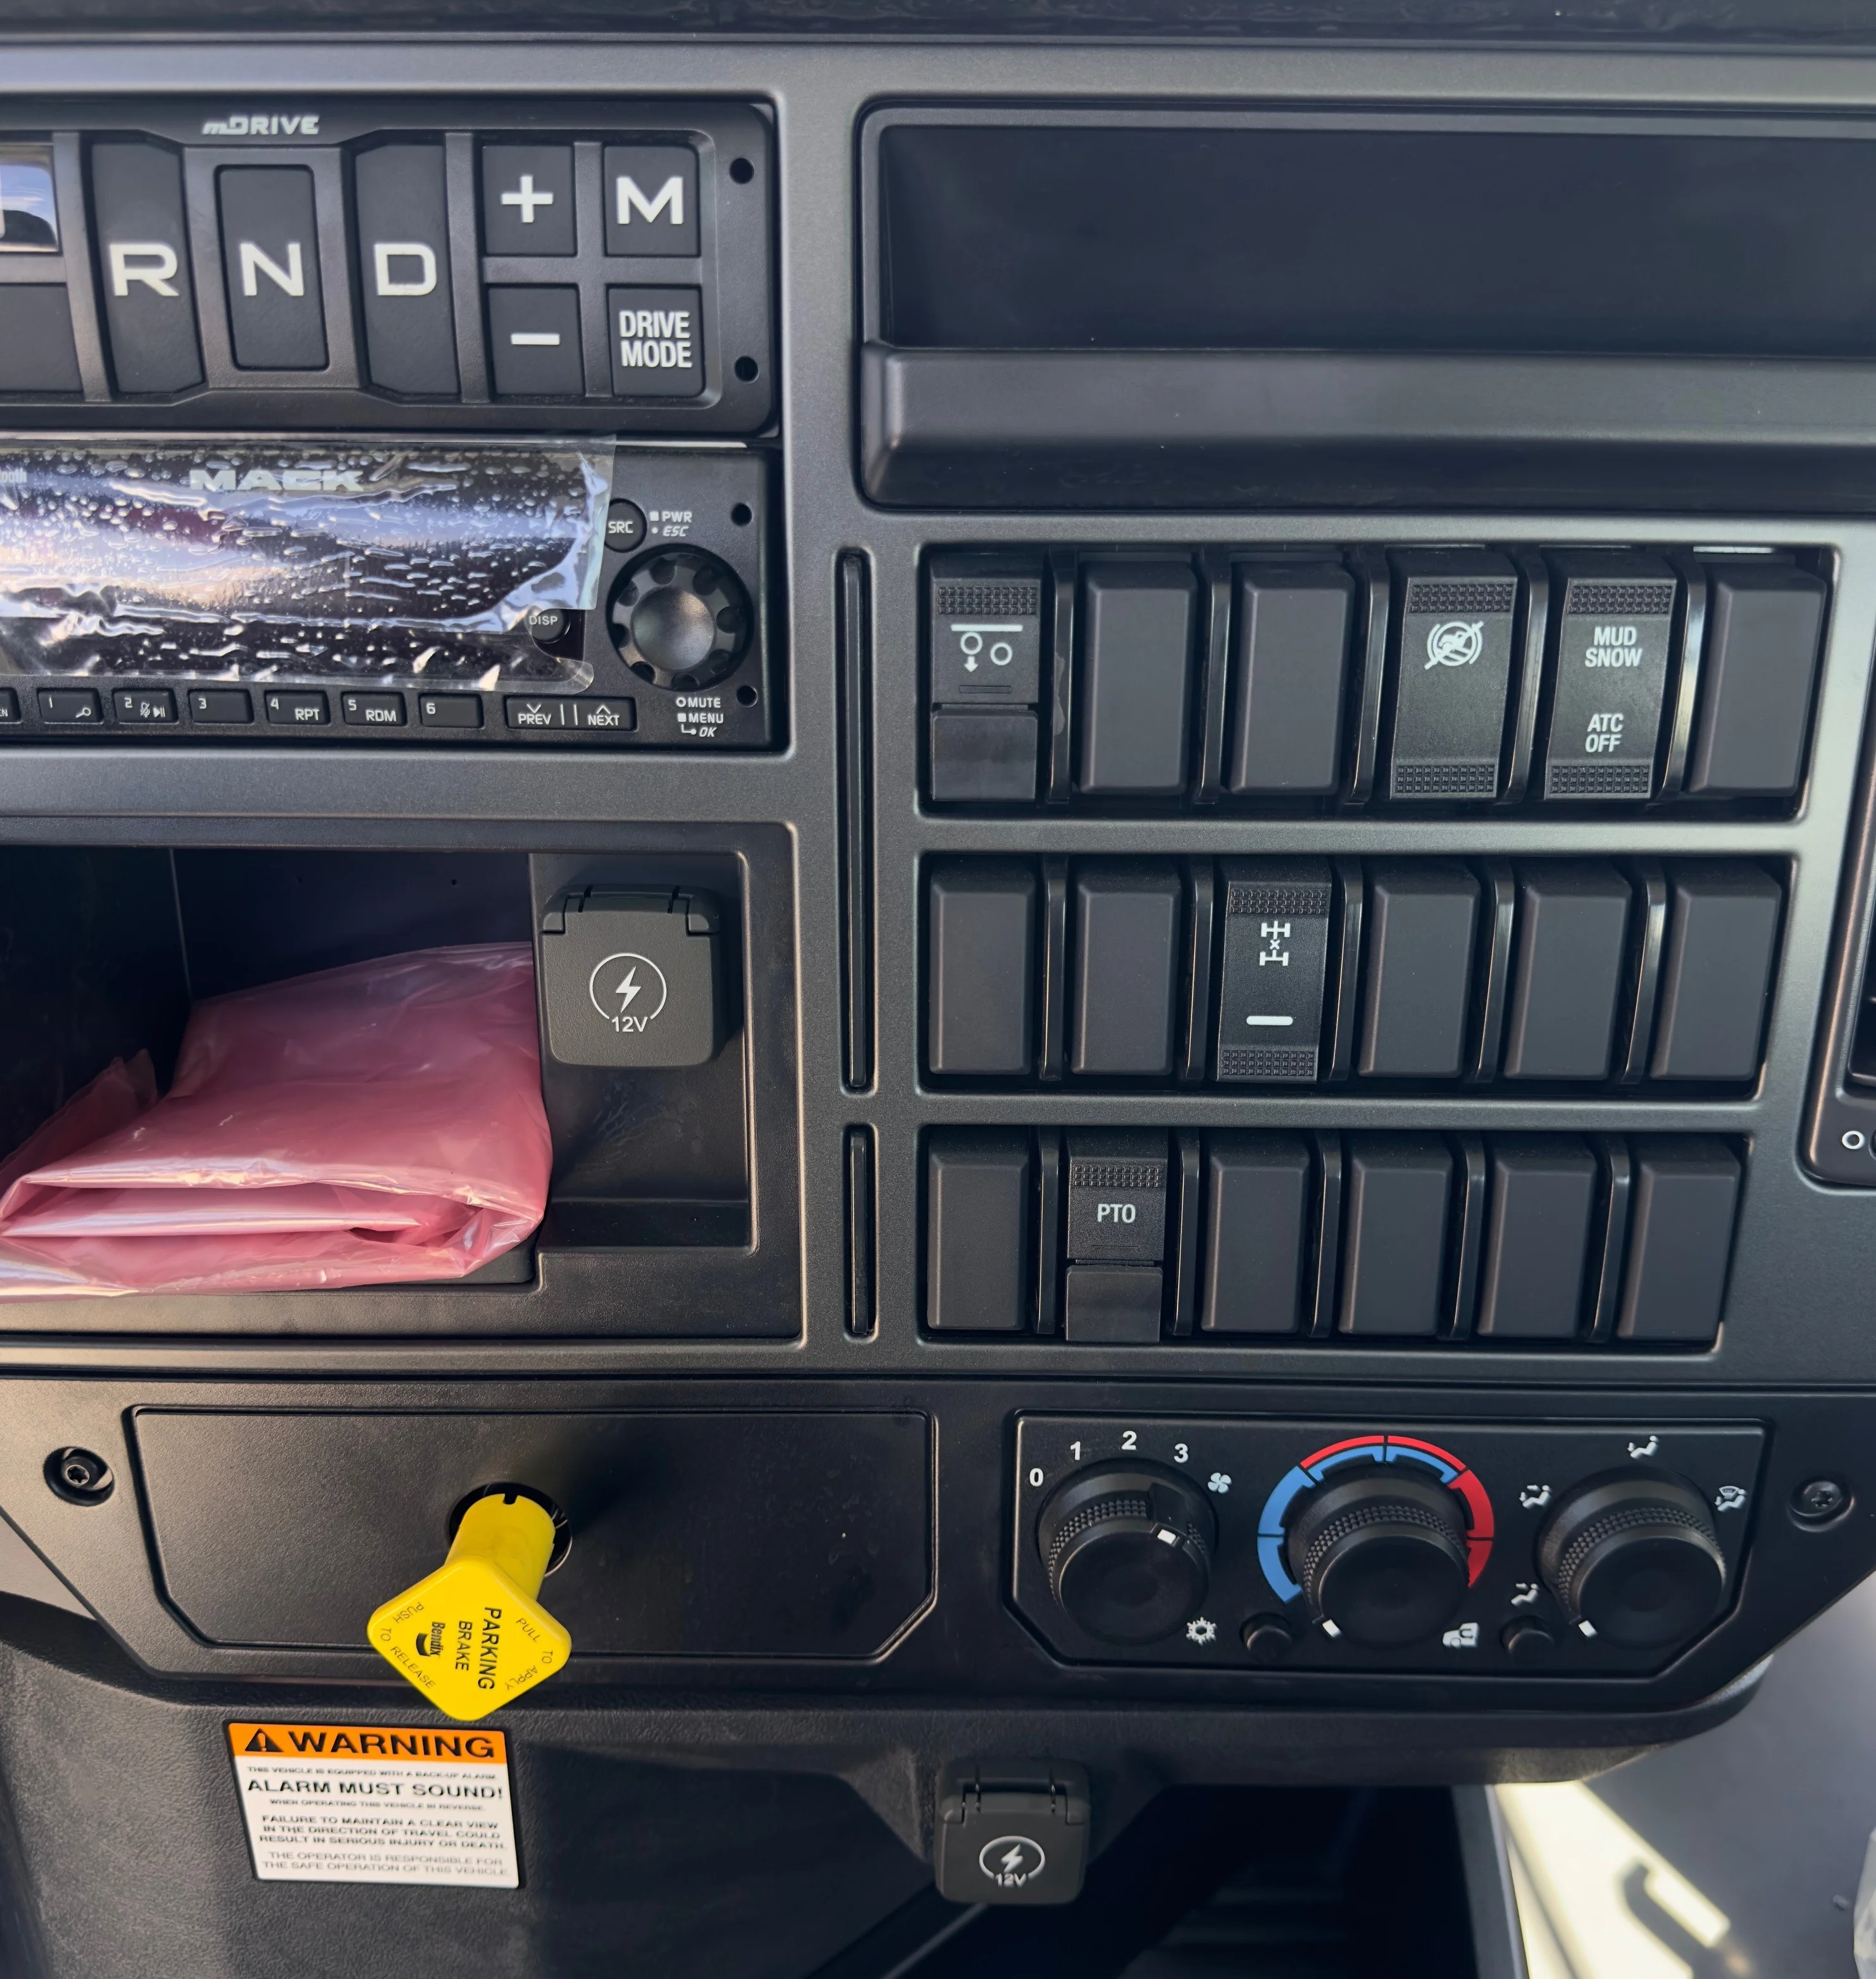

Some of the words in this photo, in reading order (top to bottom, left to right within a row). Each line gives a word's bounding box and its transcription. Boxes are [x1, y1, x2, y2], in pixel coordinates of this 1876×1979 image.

[616, 176, 683, 225] M
[109, 243, 179, 296] R
[240, 243, 304, 296] N
[374, 243, 438, 296] D
[619, 310, 690, 339] DRIVE
[621, 340, 693, 368] MODE
[190, 469, 363, 491] MACK
[661, 511, 692, 523] PWR
[608, 521, 633, 534] SRC
[662, 525, 690, 537] ESC
[529, 615, 558, 626] DISP
[1593, 626, 1638, 647] MUD
[1584, 647, 1643, 668] SNOW
[124, 697, 133, 709] 2
[199, 697, 207, 709] 3
[270, 698, 280, 710] 4
[348, 699, 357, 711] 5
[426, 702, 436, 715] 6
[688, 697, 721, 708] MUTE
[295, 709, 320, 721] RPT
[366, 709, 397, 722] RDM
[518, 713, 552, 725] PREV
[587, 714, 620, 727] NEXT
[688, 713, 724, 724] MENU
[1586, 713, 1624, 733] ATC
[699, 727, 717, 737] OK
[1585, 734, 1622, 753] OFF
[612, 1016, 648, 1032] 12V
[1096, 1204, 1136, 1223] PTO
[1122, 1430, 1137, 1451] 2
[1070, 1441, 1081, 1460] 1
[1174, 1443, 1189, 1463] 3
[1029, 1468, 1043, 1487] 0
[392, 1602, 425, 1623] PUSH
[380, 1627, 392, 1642] TO
[430, 1621, 445, 1656] Bendix
[516, 1618, 540, 1643] PULL
[455, 1620, 473, 1671] BRAKE
[478, 1606, 502, 1690] PARKING
[542, 1650, 553, 1664] TO
[390, 1645, 437, 1689] RELEASE
[504, 1665, 538, 1690] APPLY
[289, 1731, 495, 1758] WARNING
[248, 1779, 331, 1794] ALARM
[339, 1782, 404, 1795] MUST
[413, 1783, 503, 1799] SOUND!
[301, 1799, 357, 1807] OPERATING
[262, 1814, 317, 1823] FAILURE
[321, 1816, 337, 1824] TO
[342, 1816, 402, 1826] MAINTAIN
[420, 1819, 462, 1827] CLEAR
[467, 1821, 498, 1829] VIEW
[280, 1825, 304, 1833] THE
[309, 1826, 377, 1835] DIRECTION
[404, 1828, 452, 1837] TRAVEL
[456, 1830, 500, 1839] COULD
[259, 1835, 309, 1843] RESULT
[330, 1837, 385, 1845] SERIOUS
[390, 1839, 435, 1847] INJURY
[269, 1851, 294, 1859] THE
[297, 1852, 366, 1861] OPERATOR
[385, 1854, 473, 1864] RESPONSIBLE
[476, 1857, 502, 1865] FOR
[291, 1861, 322, 1870] SAFE
[327, 1863, 399, 1871] OPERATION
[425, 1865, 451, 1873] THIS
[995, 1873, 1027, 1888] 12V
